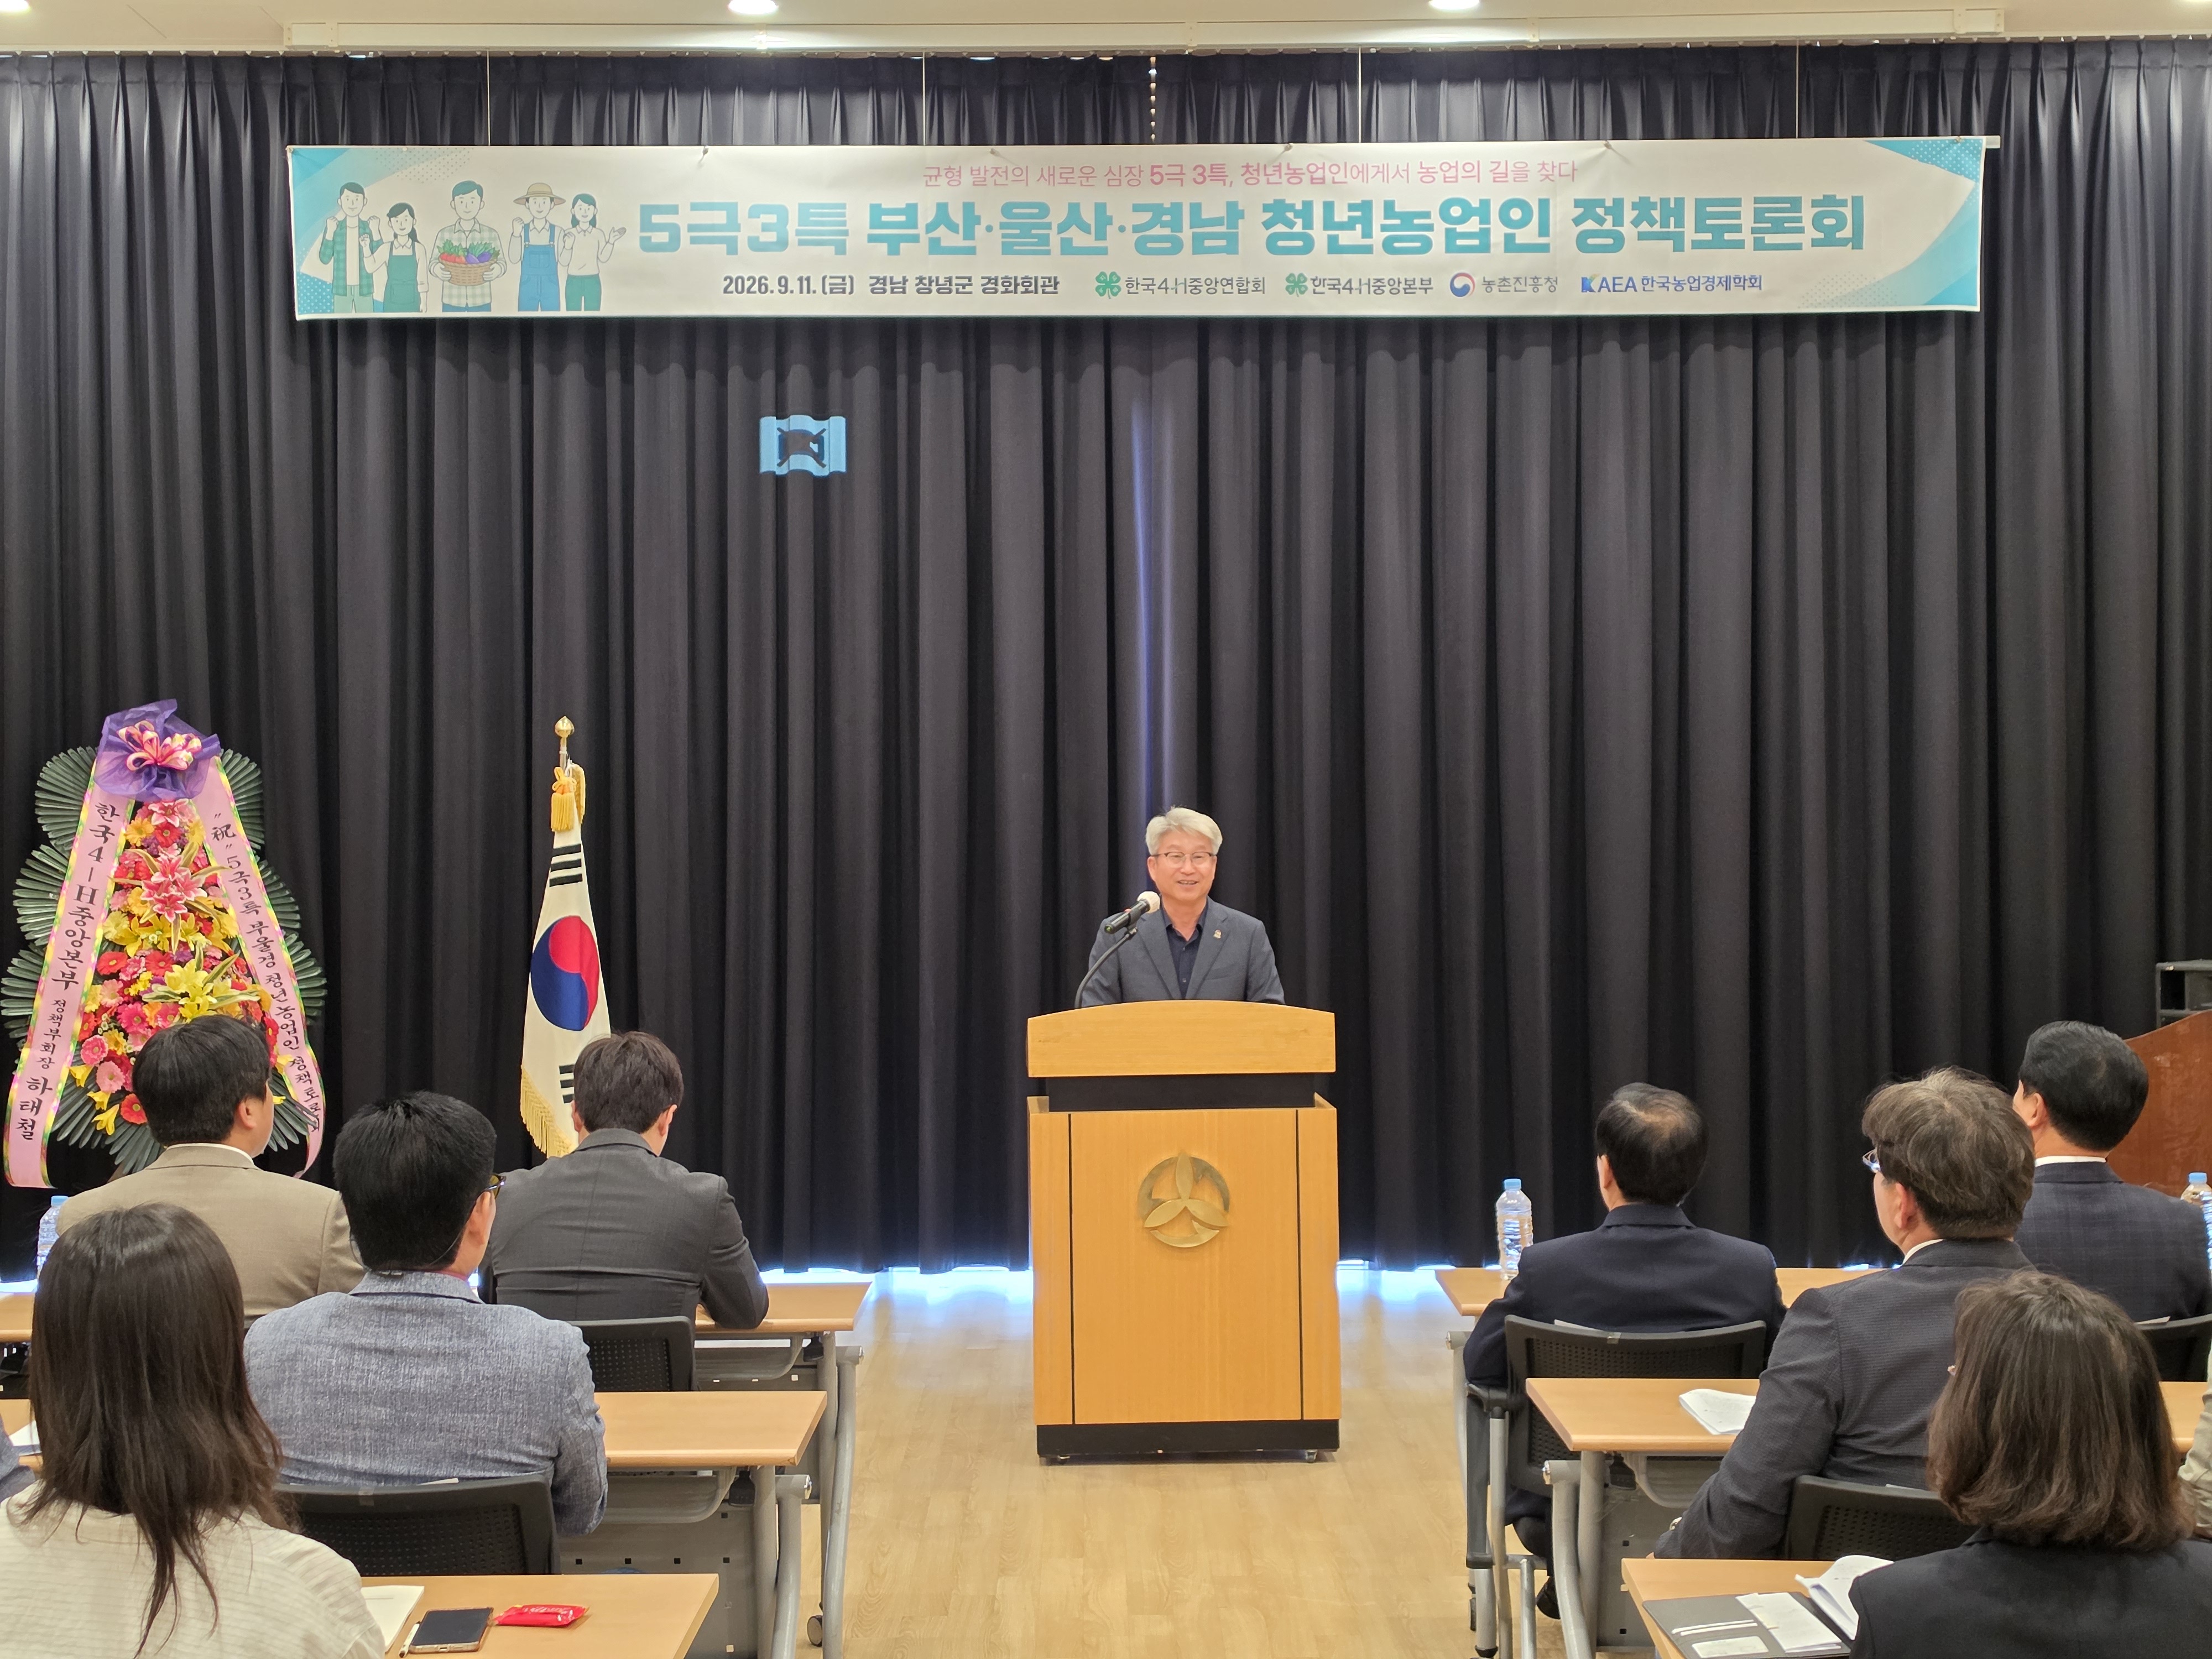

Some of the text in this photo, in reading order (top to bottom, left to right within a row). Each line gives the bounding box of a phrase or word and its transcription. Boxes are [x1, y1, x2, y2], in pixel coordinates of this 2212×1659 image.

[922, 160, 1578, 187] 균형 발전의 새로운 심장 5극 3특, 청년농업인에게서 농업의 길을 찾다
[639, 194, 1865, 256] 5극3특 부산·울산·경남 청년농업인 정책토론회
[869, 275, 909, 295] 경남
[915, 275, 974, 295] 창녕군
[980, 274, 1060, 295] 경화회관
[1481, 275, 1558, 294] 농촌진흥청
[1580, 272, 1763, 293] KAEA 한국농업경제학회
[227, 855, 262, 916] 5극3특
[246, 920, 276, 968] 부울경
[264, 972, 300, 1050] 청년농업인
[36, 998, 66, 1070] 정책부회장
[15, 1076, 53, 1141] 하태철
